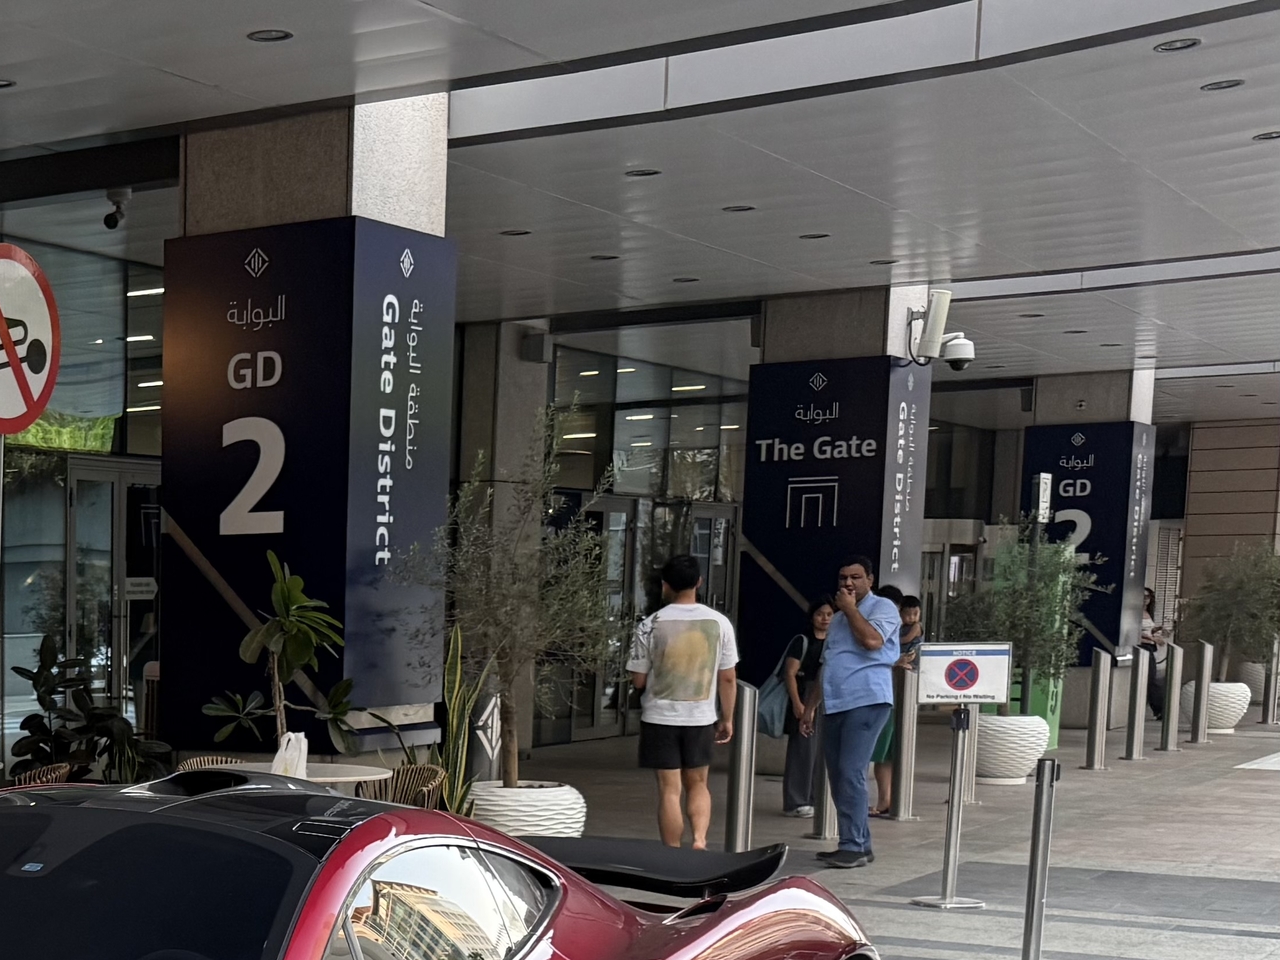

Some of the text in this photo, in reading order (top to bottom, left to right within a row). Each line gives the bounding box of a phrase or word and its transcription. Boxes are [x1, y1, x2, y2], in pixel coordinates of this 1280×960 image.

[226, 294, 286, 331] البوابة
[227, 350, 283, 390] GD
[405, 299, 424, 470] منطقة البوابة
[375, 293, 400, 566] Gate District
[794, 401, 839, 425] البوابة
[755, 435, 877, 462] The Gate
[1059, 453, 1095, 471] البوابة
[219, 416, 286, 536] 2
[891, 401, 908, 573] Gate District
[1058, 478, 1092, 497] GD
[1054, 508, 1092, 564] 2
